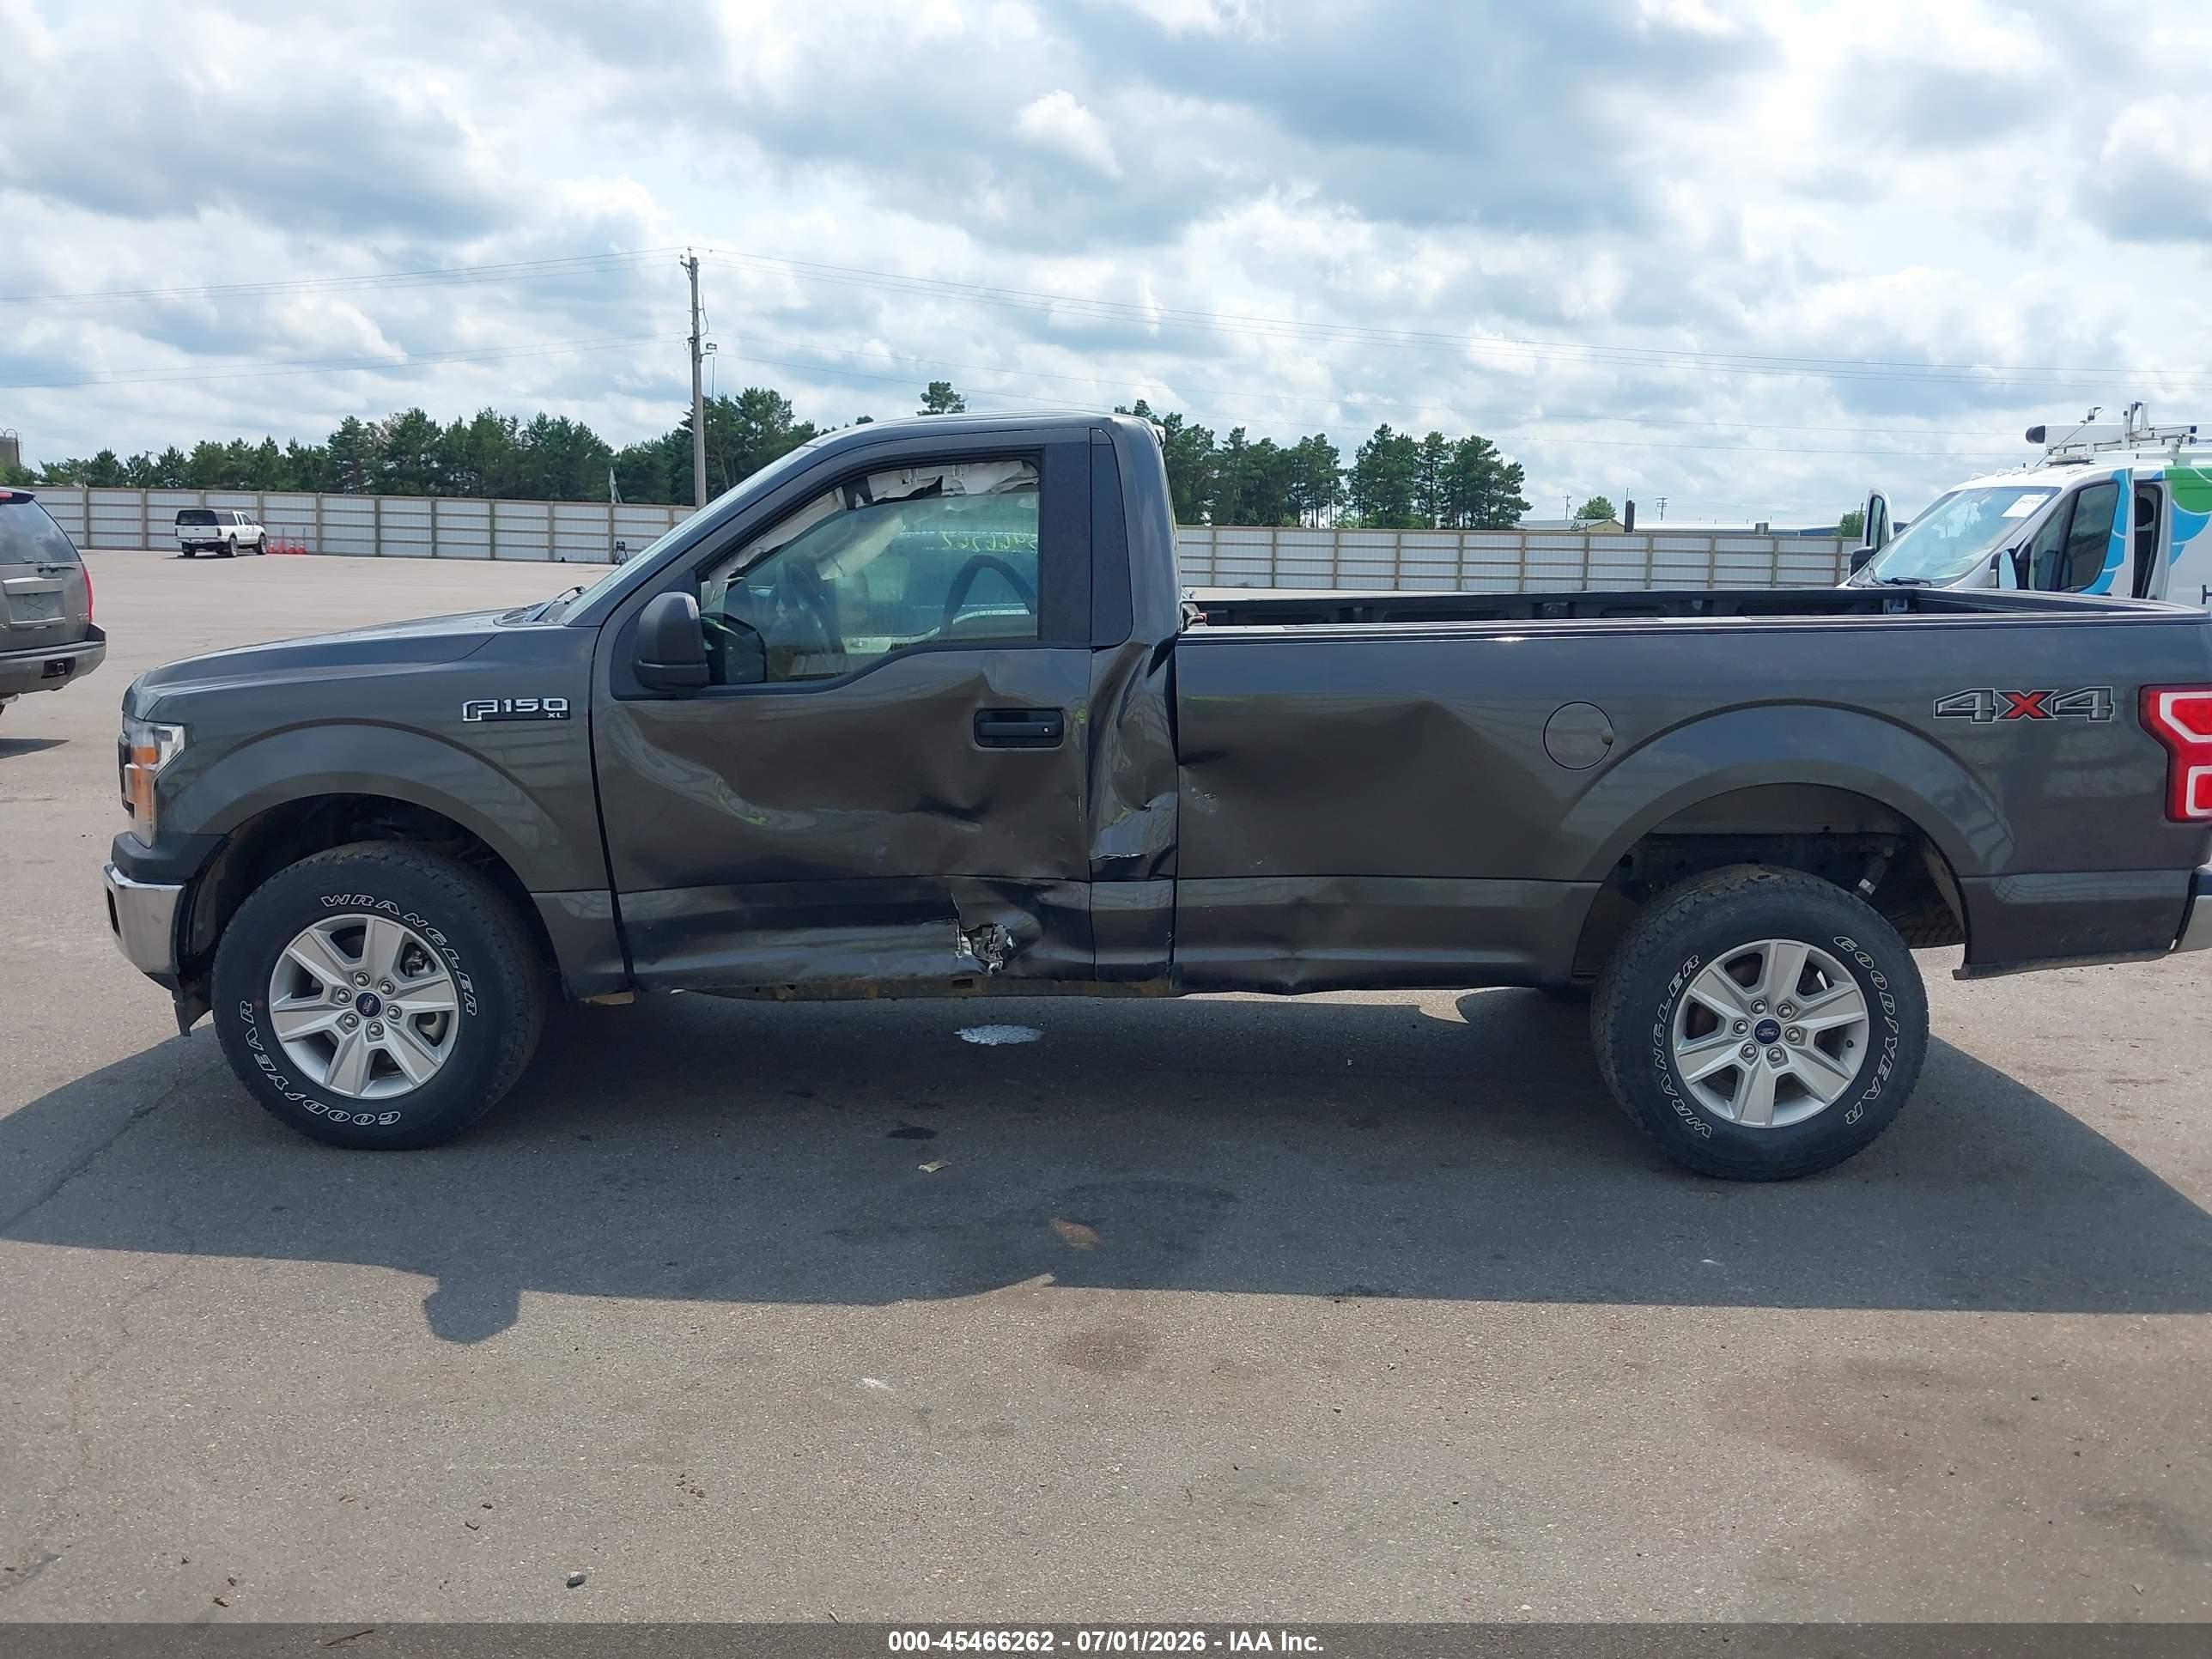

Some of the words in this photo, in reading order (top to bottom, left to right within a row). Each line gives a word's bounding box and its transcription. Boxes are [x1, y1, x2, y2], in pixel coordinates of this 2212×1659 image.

[320, 894, 477, 1017] WRANGLER
[1833, 936, 1899, 1125] GOODYEAR
[238, 1000, 402, 1127] GOODYEAR
[1651, 955, 1712, 1138] WRANGLER
